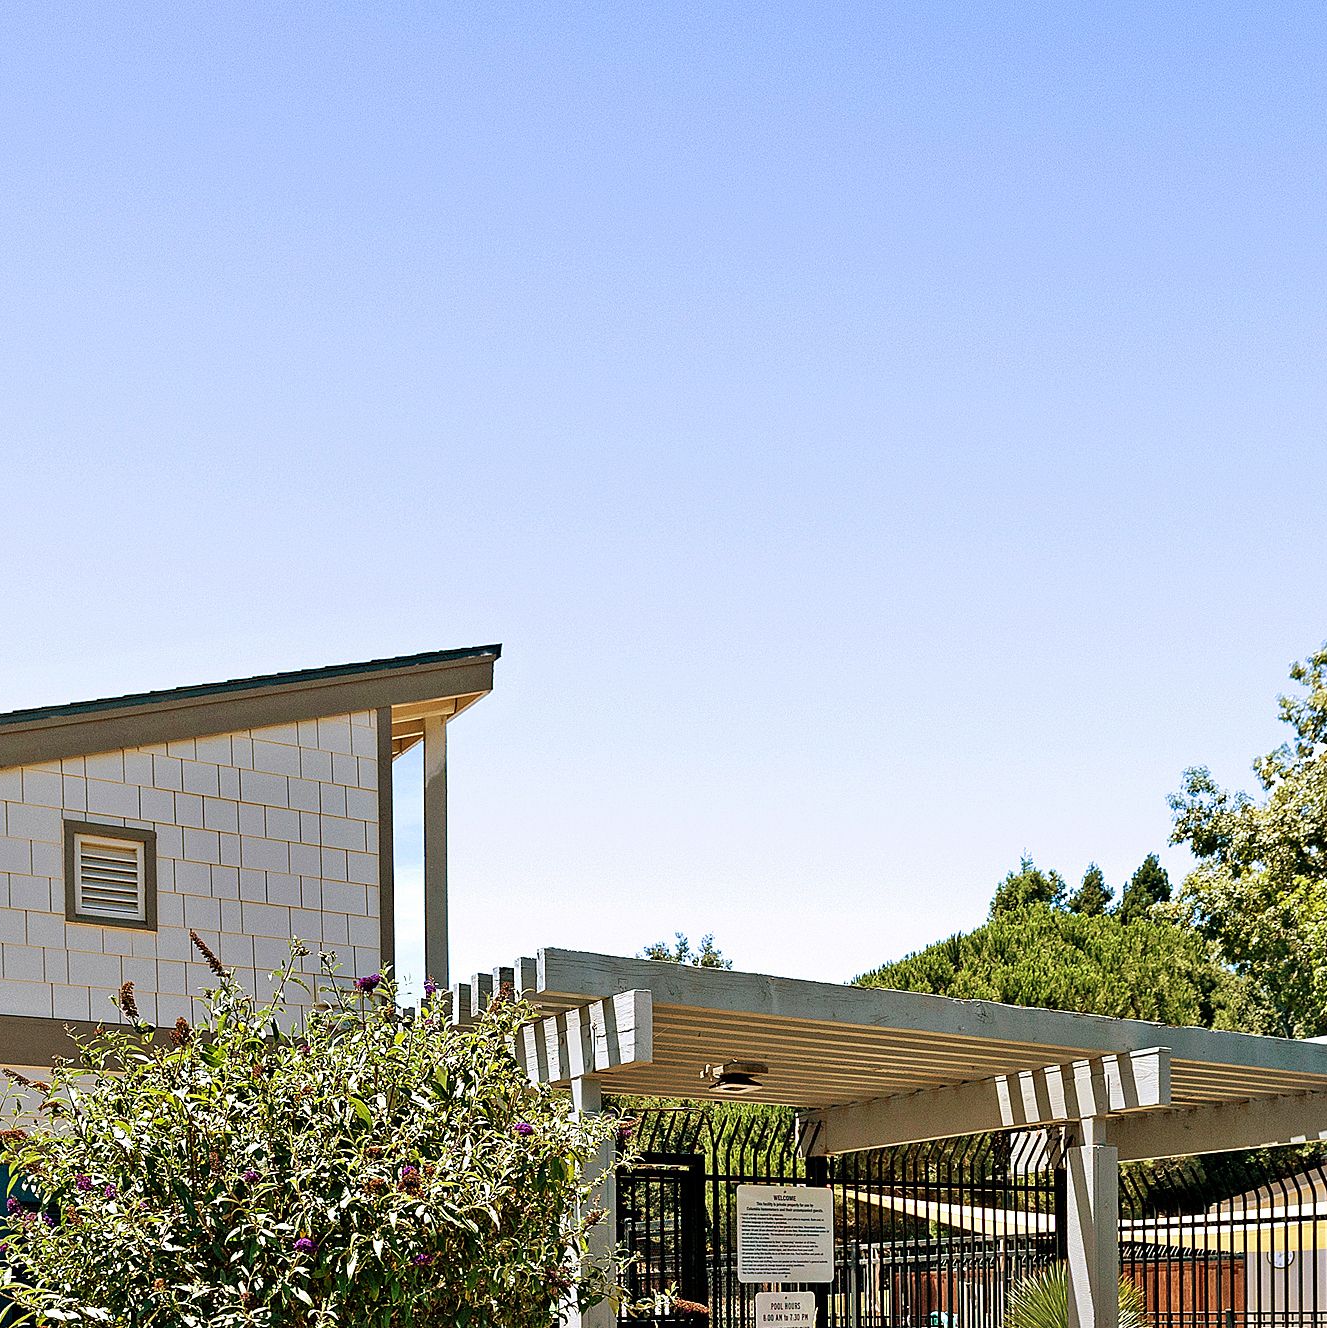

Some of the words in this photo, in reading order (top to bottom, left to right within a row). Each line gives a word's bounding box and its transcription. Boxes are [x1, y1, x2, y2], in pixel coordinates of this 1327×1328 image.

[770, 1302, 783, 1310] POOL
[784, 1302, 801, 1310] HOURS
[775, 1313, 783, 1321] AM
[802, 1313, 809, 1321] PM
